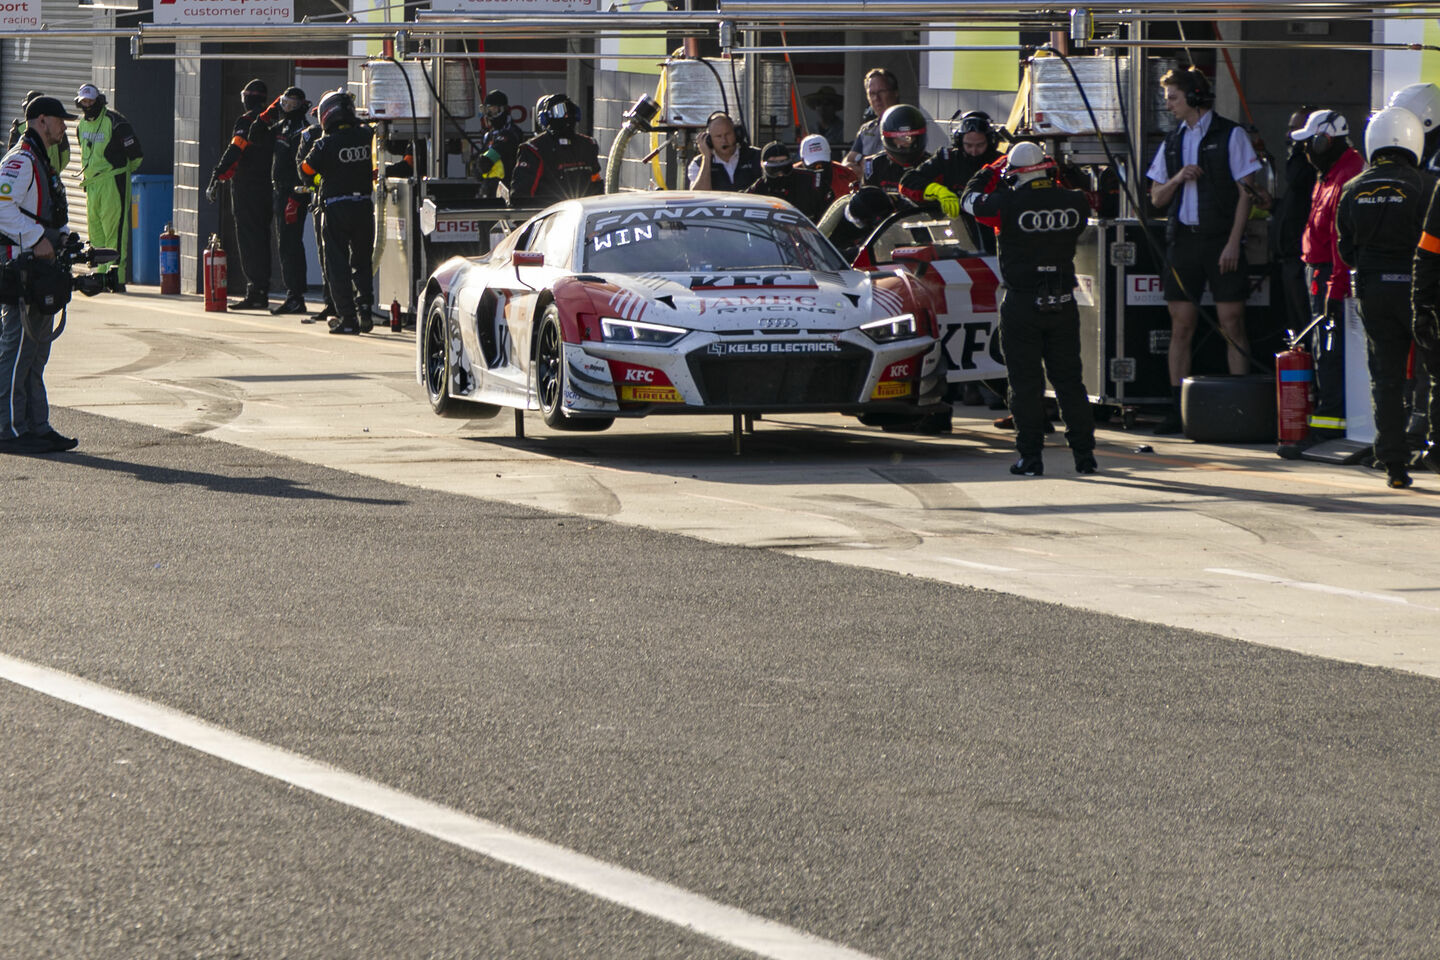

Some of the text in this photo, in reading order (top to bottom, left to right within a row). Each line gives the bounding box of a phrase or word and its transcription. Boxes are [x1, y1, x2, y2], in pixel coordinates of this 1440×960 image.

[184, 6, 290, 18] customer racing
[3, 16, 38, 26] racing
[594, 207, 800, 231] FANATEC
[594, 224, 653, 251] WIN
[690, 274, 792, 288] KFC
[698, 295, 817, 316] JAMEC
[717, 306, 836, 315] RACING
[728, 342, 842, 353] KELSO ELECTRICAL
[625, 369, 654, 382] KFC
[890, 365, 908, 377] KFC
[632, 387, 676, 400] PIRELLI
[878, 383, 906, 396] PIRELLI
